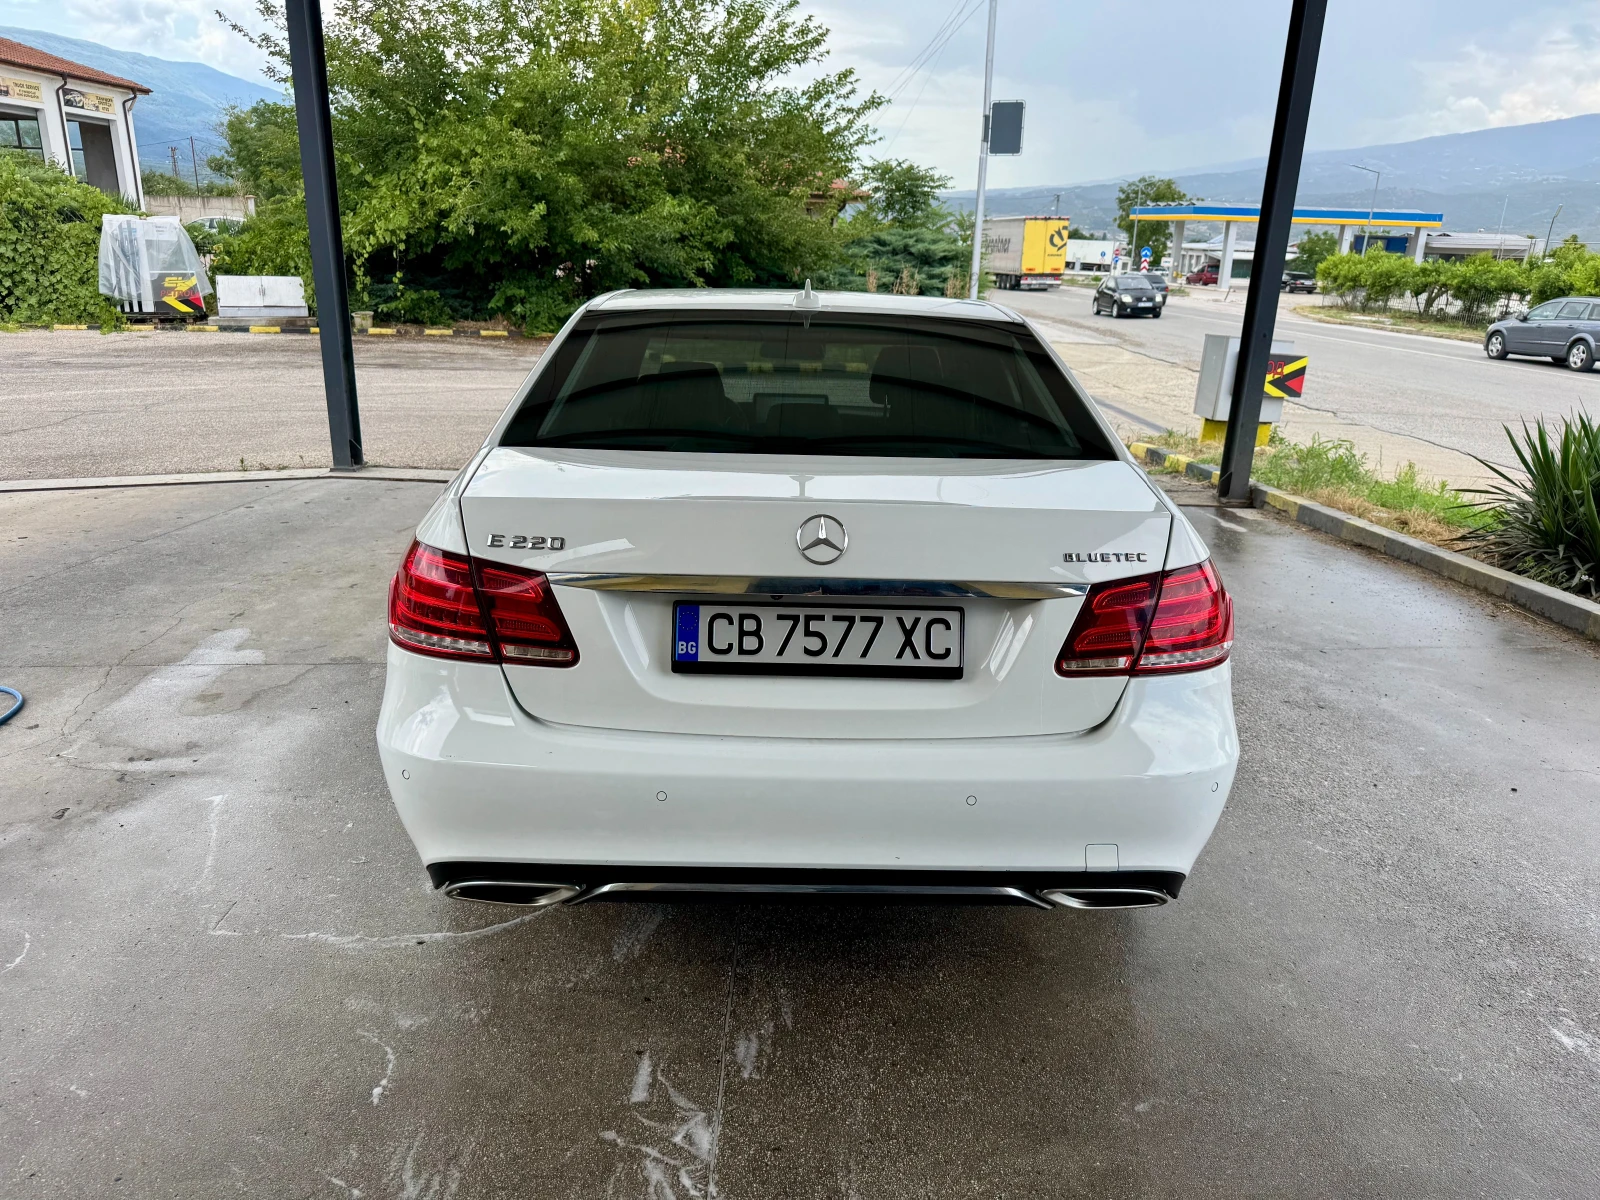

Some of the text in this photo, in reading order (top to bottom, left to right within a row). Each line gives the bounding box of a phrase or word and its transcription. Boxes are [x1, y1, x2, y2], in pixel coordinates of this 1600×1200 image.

[160, 289, 198, 298] PETROL
[486, 533, 566, 551] E 220
[1062, 552, 1147, 563] BLUETEC
[707, 612, 952, 660] CB 7577 XC
[678, 641, 697, 654] BG
